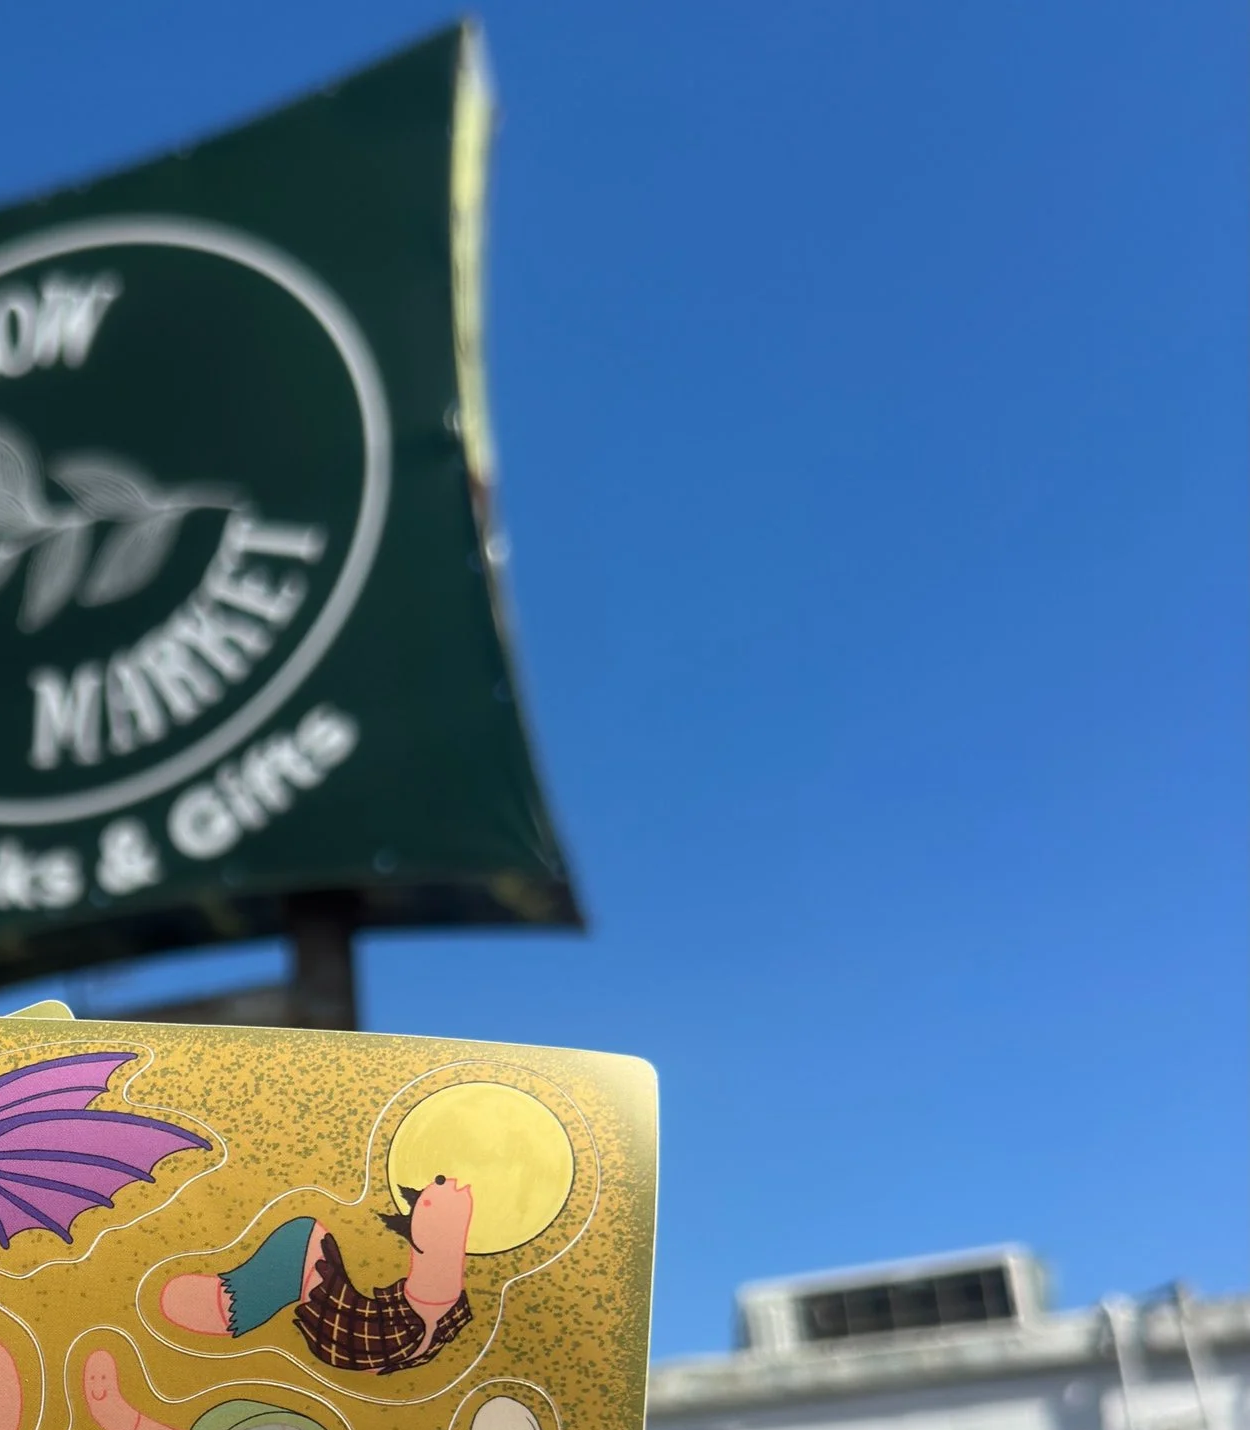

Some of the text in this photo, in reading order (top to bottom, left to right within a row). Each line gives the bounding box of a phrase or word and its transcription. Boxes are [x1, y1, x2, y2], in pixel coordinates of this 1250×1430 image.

[29, 510, 327, 769] MARKET
[96, 818, 161, 895] &
[168, 703, 358, 859] Gifts
